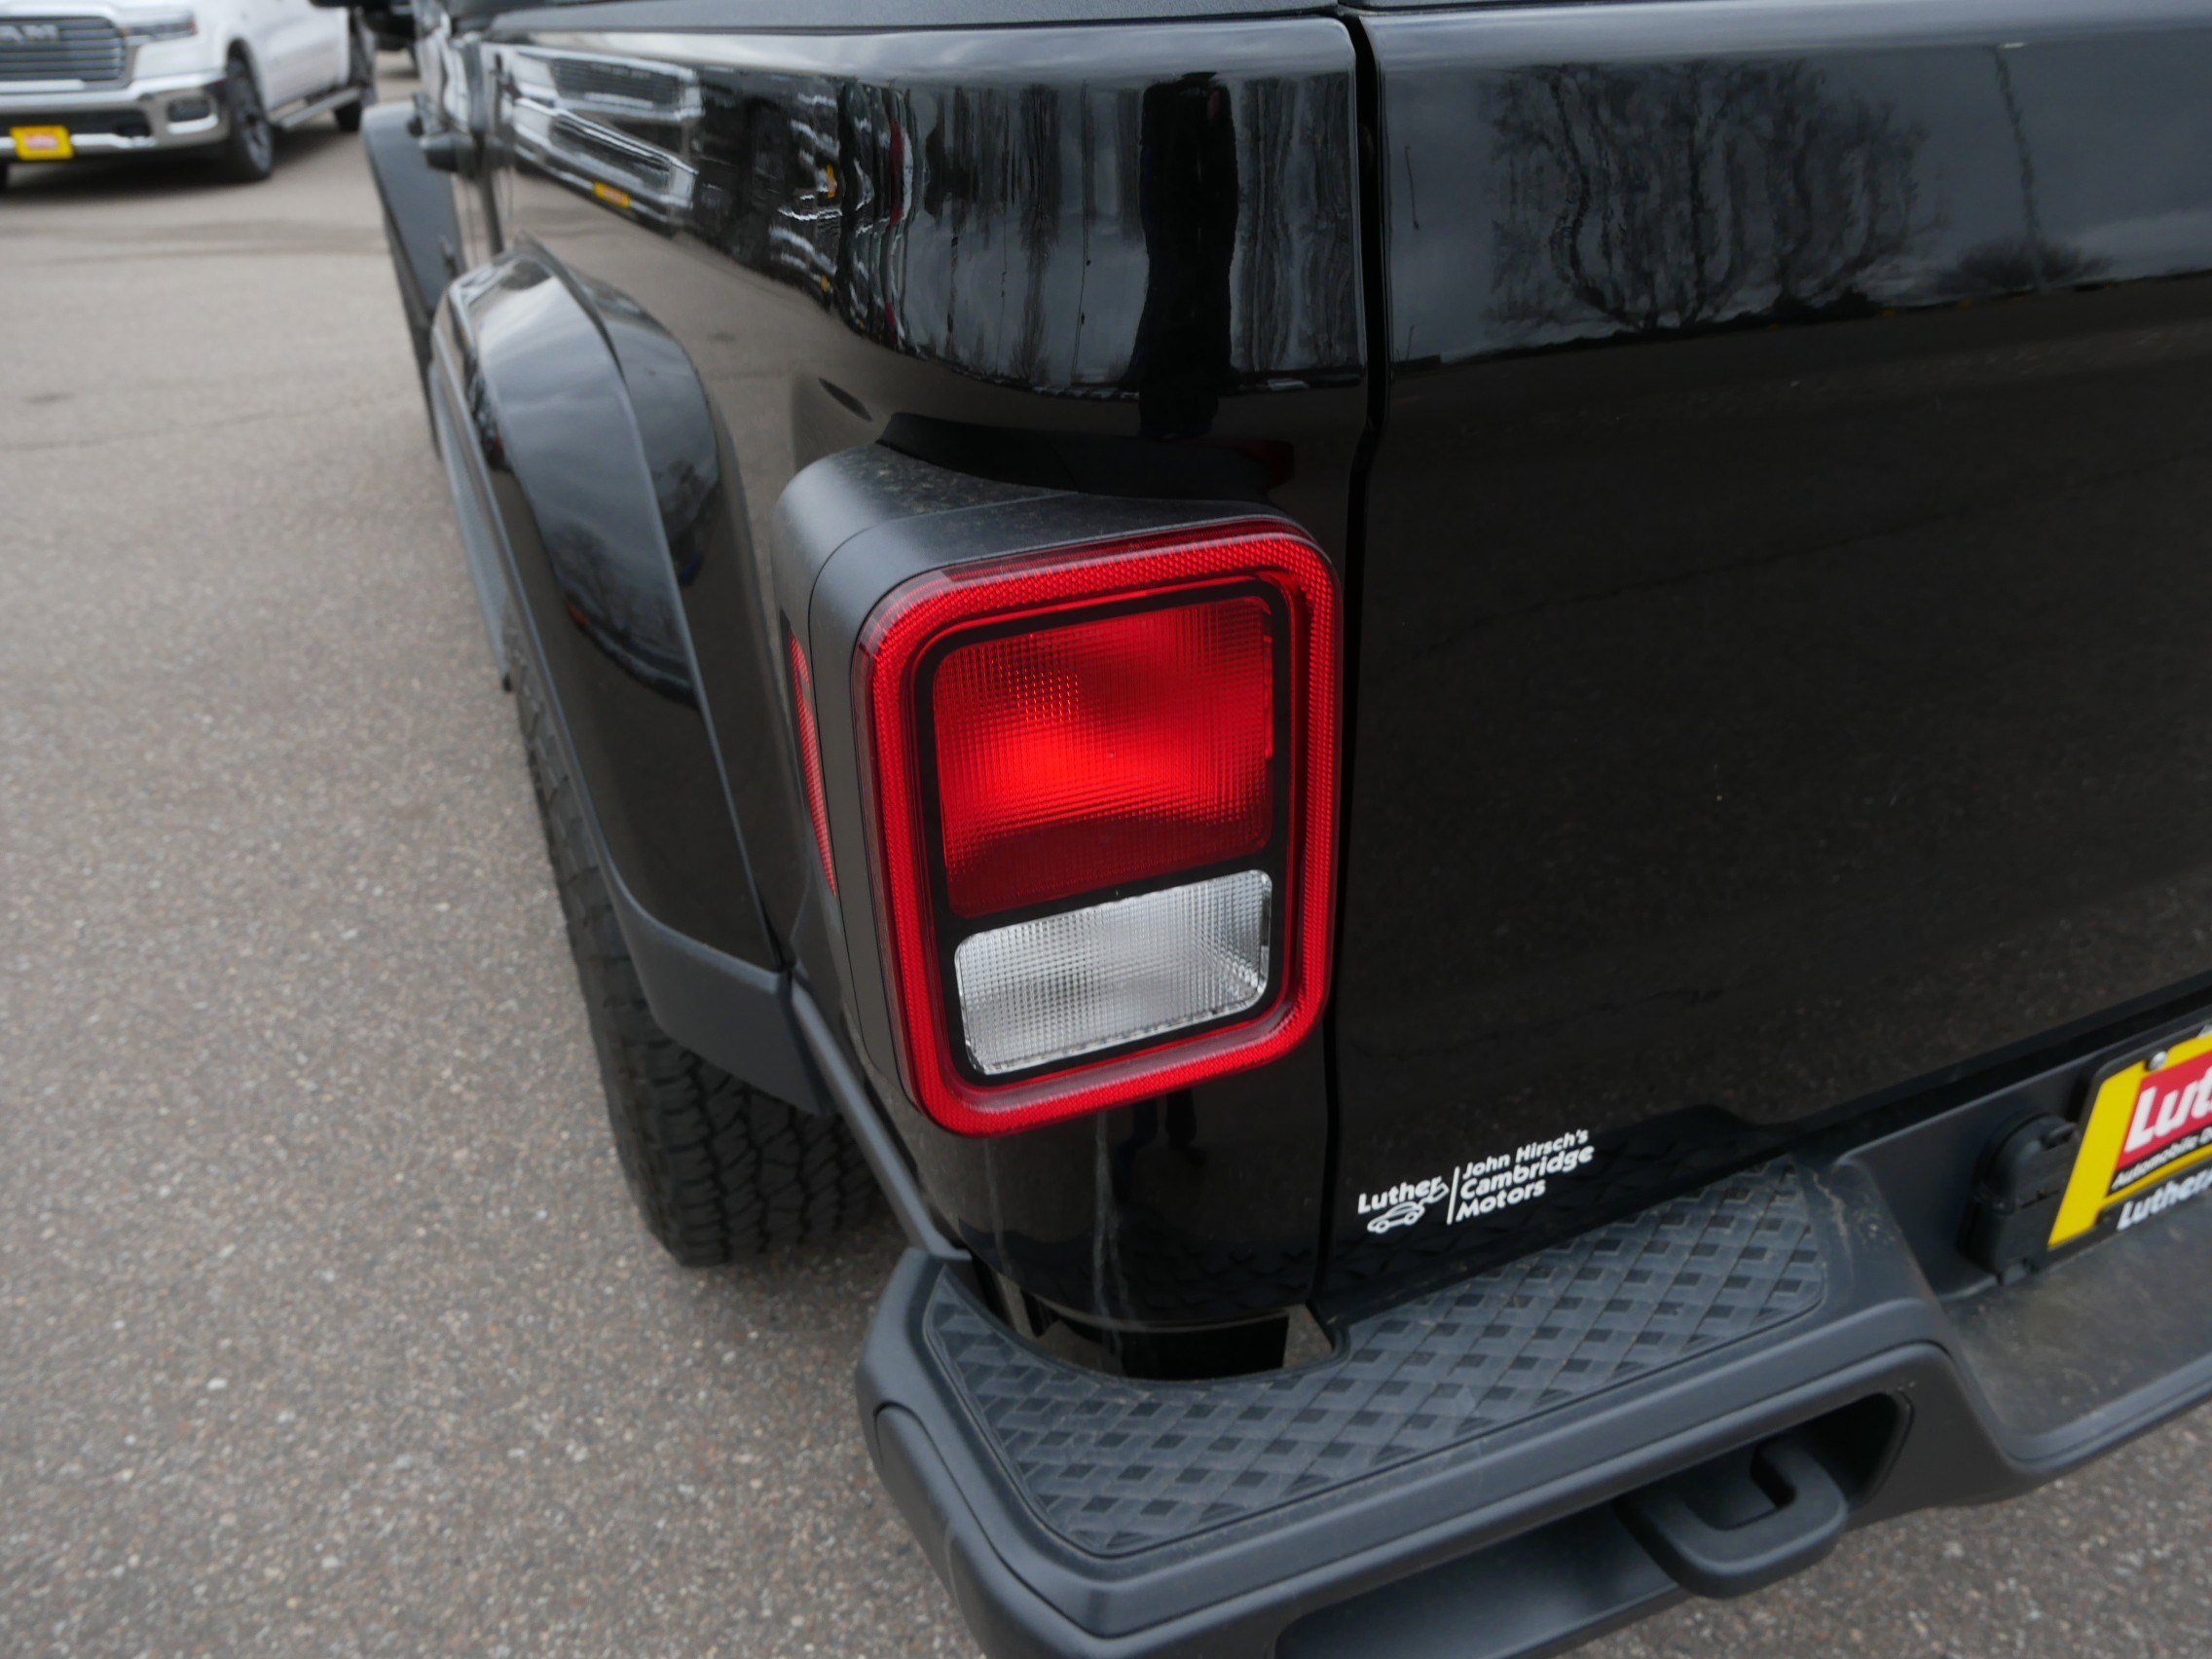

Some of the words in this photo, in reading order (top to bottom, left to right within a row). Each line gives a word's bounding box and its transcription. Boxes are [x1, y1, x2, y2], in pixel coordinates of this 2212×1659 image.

[2123, 1066, 2212, 1154] Lut
[1460, 1145, 1595, 1199] Cambridge
[1462, 1154, 1510, 1180] John
[1515, 1128, 1589, 1163] Hirsch's
[1358, 1175, 1443, 1214] Luther
[1456, 1179, 1546, 1222] Motors
